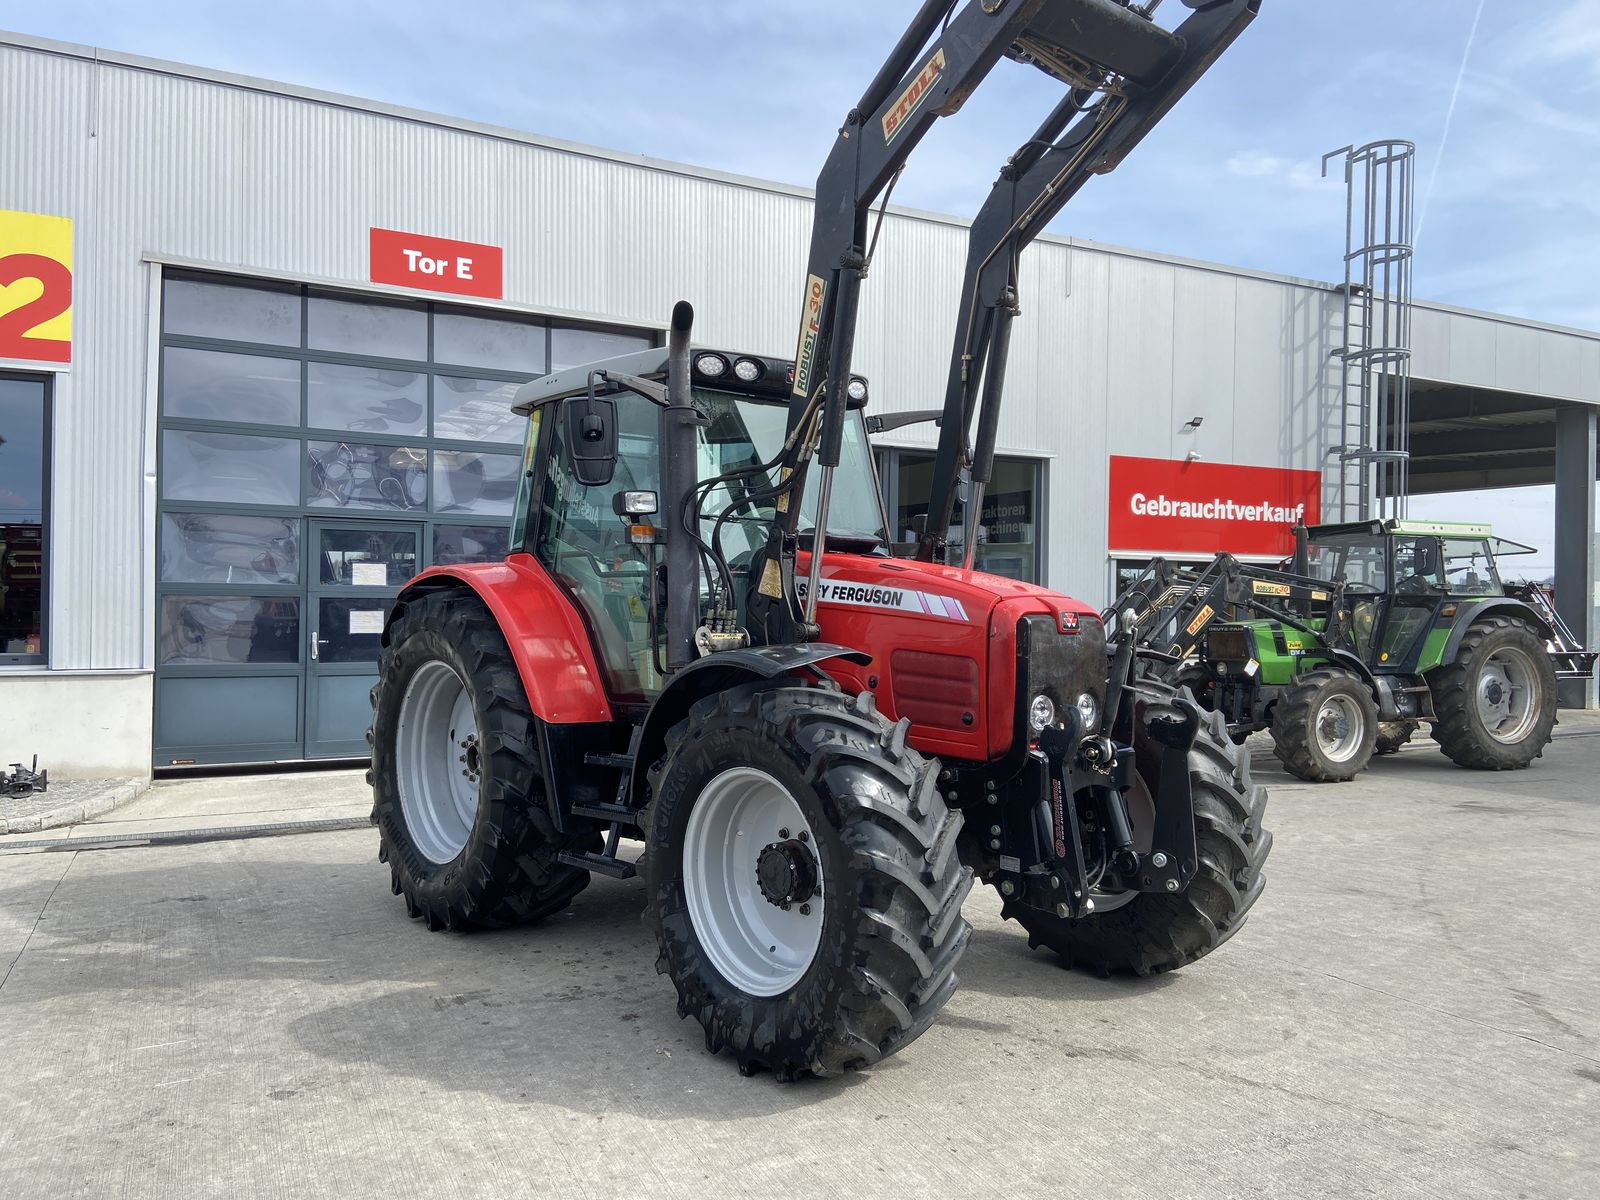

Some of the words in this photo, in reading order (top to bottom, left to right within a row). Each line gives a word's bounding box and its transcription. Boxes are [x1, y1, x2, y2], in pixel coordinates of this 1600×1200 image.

[886, 57, 942, 136] STOLL
[402, 248, 449, 276] Tor
[456, 256, 473, 280] E
[0, 253, 73, 363] 2
[797, 330, 816, 393] ROBUST
[981, 504, 1026, 518] raktoren
[1130, 492, 1305, 524] Gebrauchtverkauf
[985, 520, 1026, 536] schinen
[831, 586, 904, 606] FERGUSON
[1189, 608, 1212, 632] STOLL
